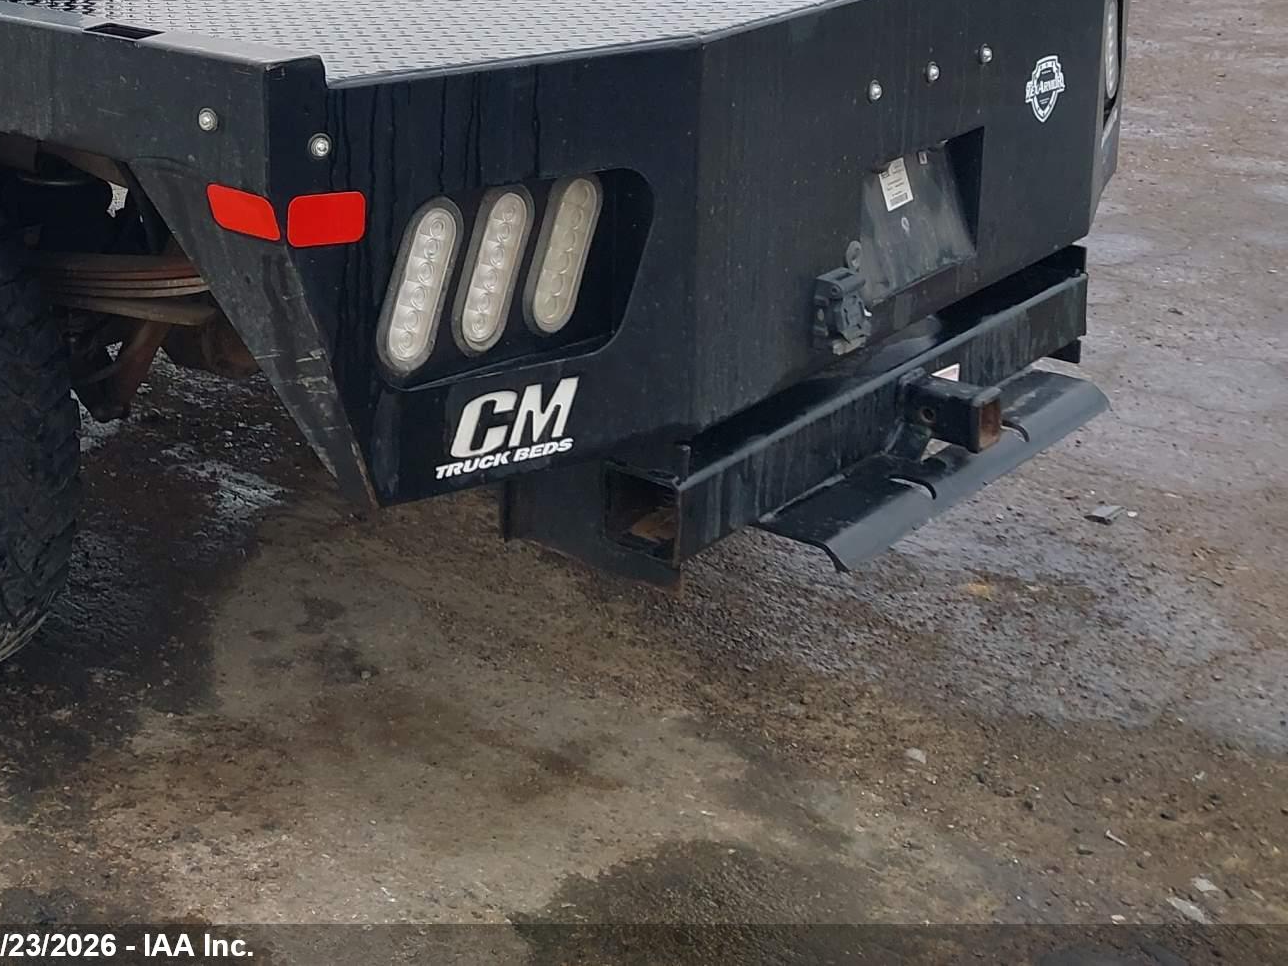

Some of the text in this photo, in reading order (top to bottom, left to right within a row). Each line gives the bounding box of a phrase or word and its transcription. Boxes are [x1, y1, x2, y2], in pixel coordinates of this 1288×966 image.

[449, 375, 581, 459] CM
[434, 436, 575, 481] TRUCK BEDS
